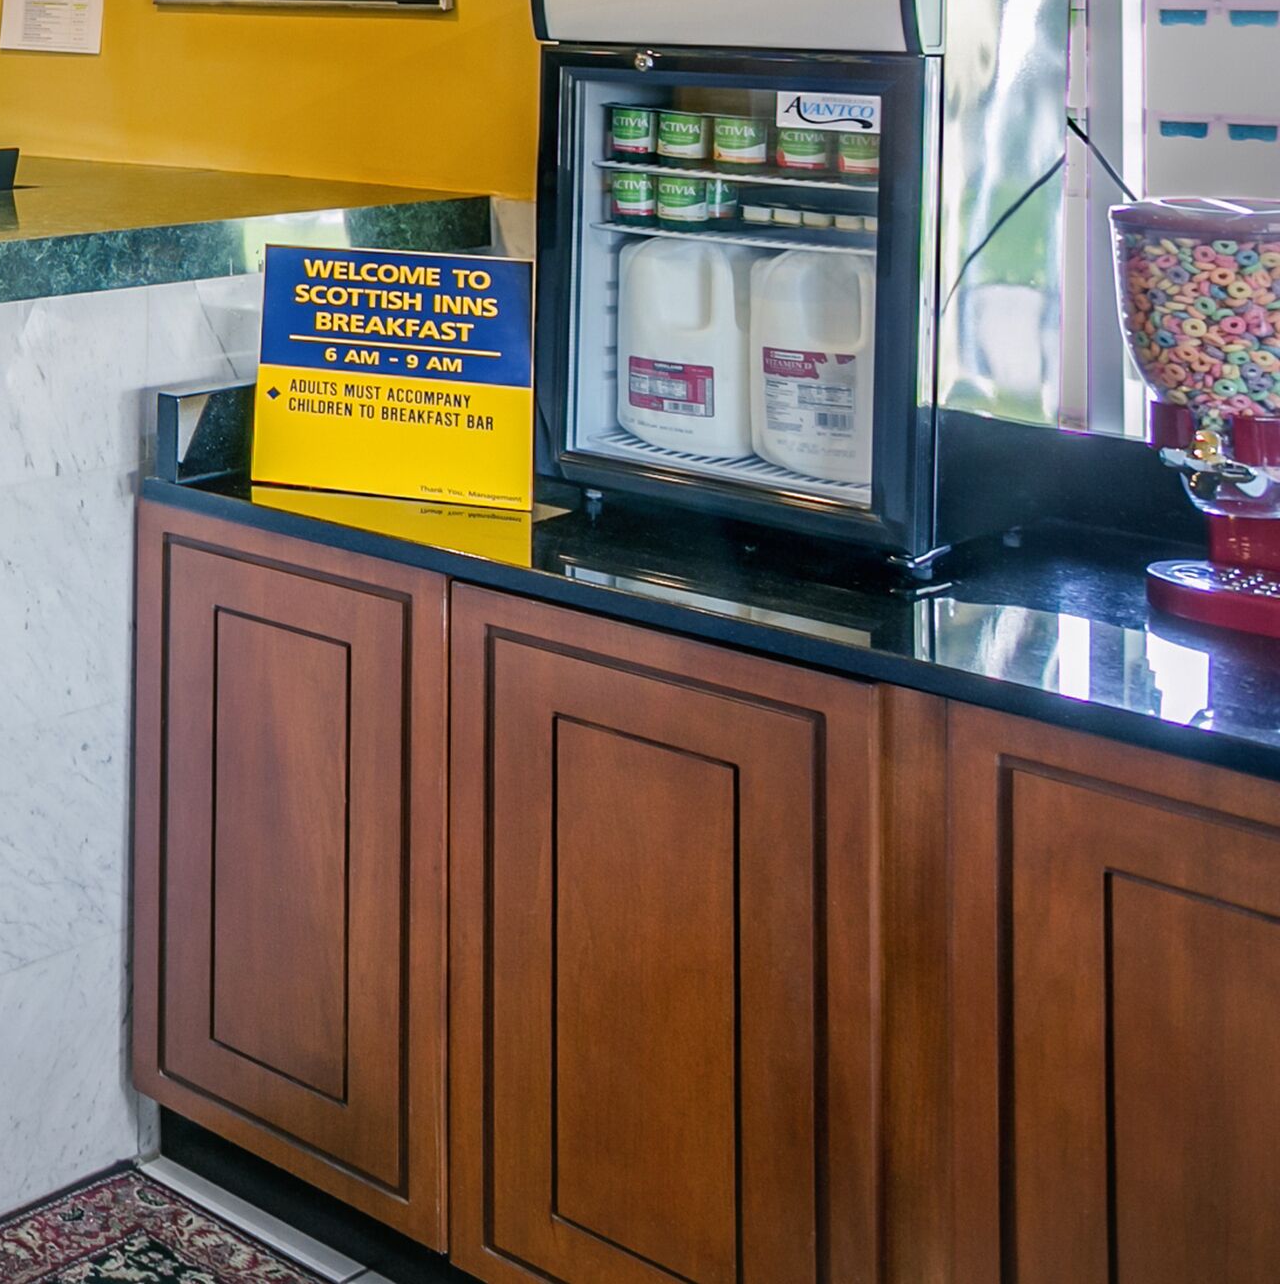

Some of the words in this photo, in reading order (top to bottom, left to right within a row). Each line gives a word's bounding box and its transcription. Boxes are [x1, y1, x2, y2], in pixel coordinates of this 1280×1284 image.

[784, 95, 874, 122] AVANTCO
[303, 258, 441, 287] WELCOME
[452, 268, 491, 291] TO
[294, 284, 422, 312] SCOTTISH
[433, 294, 499, 318] INNS
[315, 311, 474, 343] BREAKFAST
[324, 347, 337, 362] 6
[344, 350, 380, 365] AM
[405, 354, 419, 369] 9
[426, 356, 463, 373] AM
[289, 379, 337, 396] ADULTS
[344, 383, 381, 400] MUST
[386, 388, 471, 409] ACCOMPANY
[288, 398, 353, 417] CHILDREN
[359, 404, 376, 419] TO
[381, 406, 461, 428] BREAKFAST
[466, 414, 494, 431] BAR
[420, 484, 443, 494] Thank
[468, 490, 522, 504] Management
